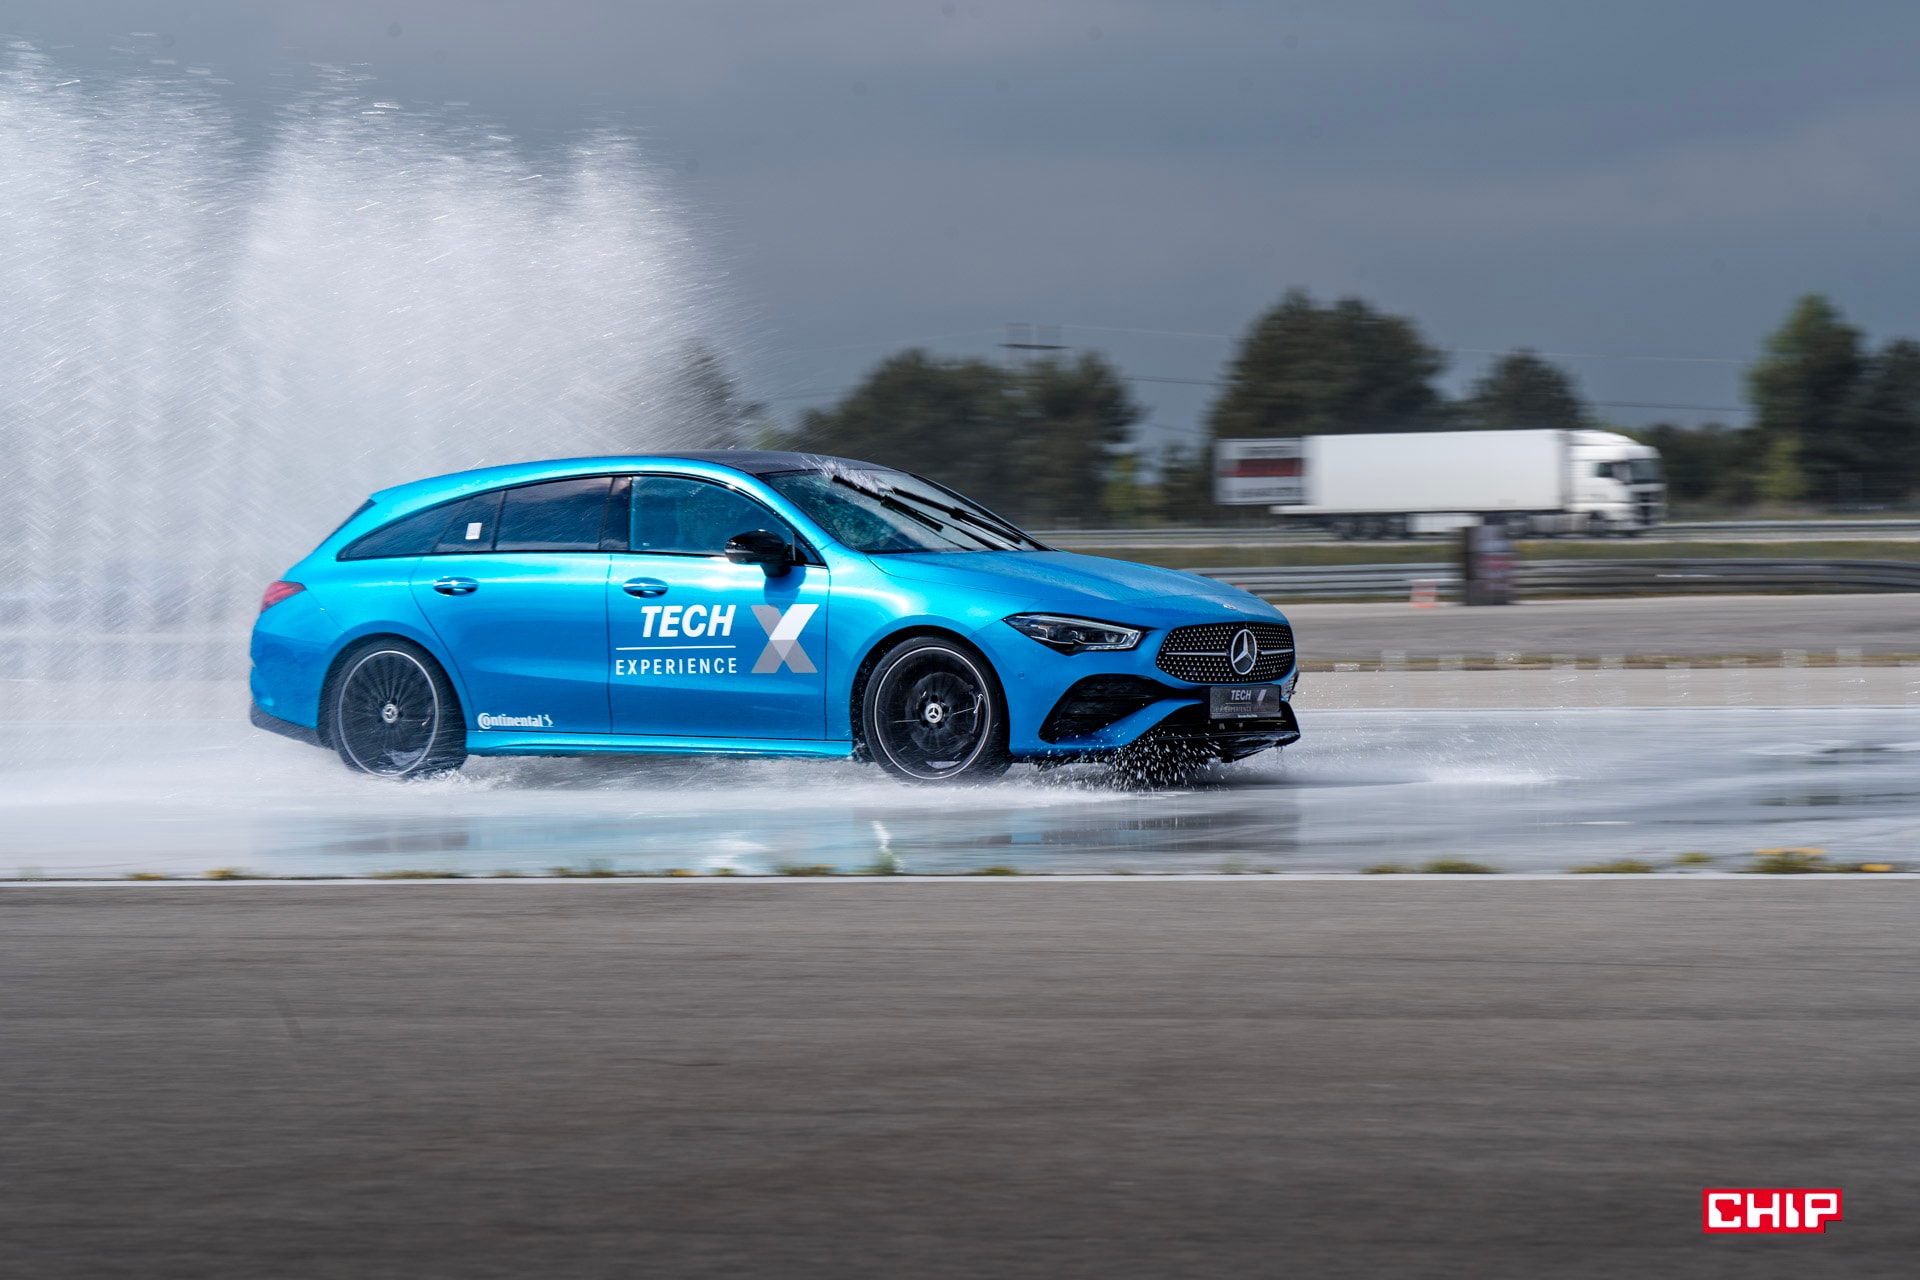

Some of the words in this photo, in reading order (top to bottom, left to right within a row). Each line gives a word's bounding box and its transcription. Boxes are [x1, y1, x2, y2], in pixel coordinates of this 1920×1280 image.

[640, 604, 737, 638] TECH
[750, 603, 820, 674] X
[615, 657, 738, 676] EXPERIENCE
[1231, 689, 1252, 701] TECH
[477, 712, 544, 730] Continental
